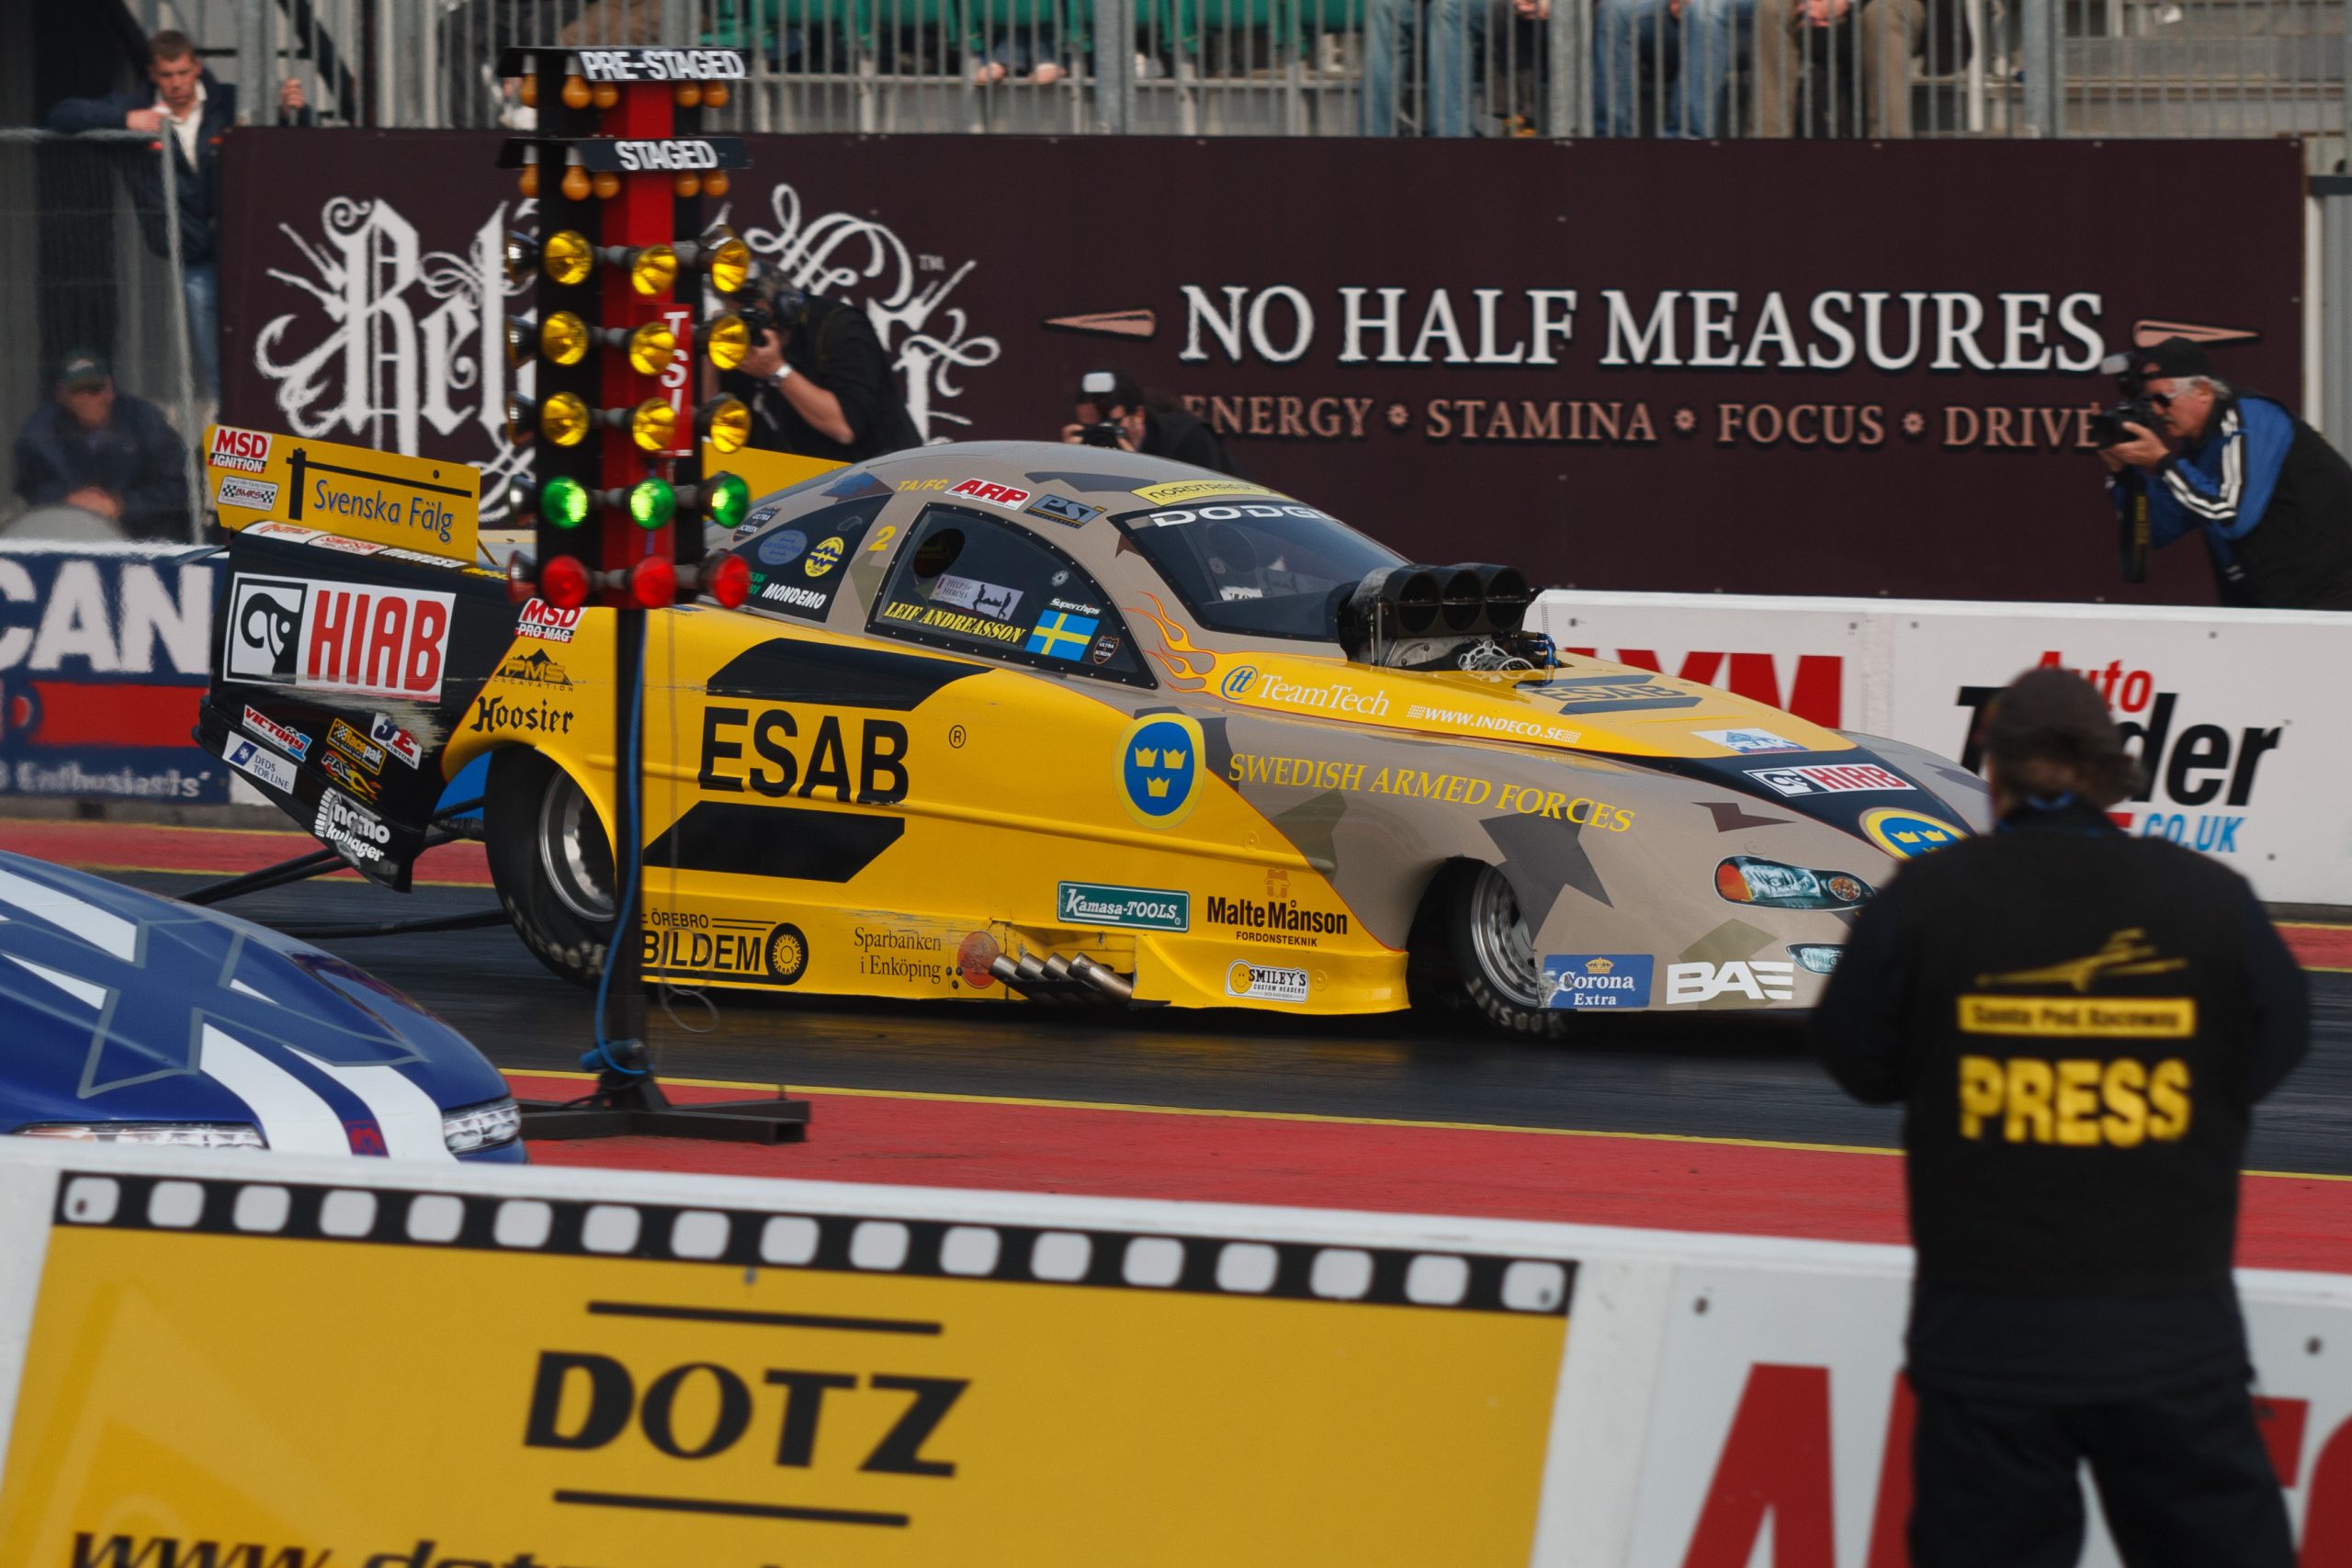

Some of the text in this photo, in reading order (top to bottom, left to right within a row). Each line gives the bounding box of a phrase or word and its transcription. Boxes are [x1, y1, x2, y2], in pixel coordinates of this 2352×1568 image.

[580, 50, 746, 80] PRE-STAGED
[615, 140, 718, 170] STAGED
[1180, 285, 2105, 371] NO HALF MEASURES
[1427, 398, 1656, 441] STAMINA
[1718, 403, 1885, 445] FOCUS
[1944, 405, 2099, 447] DRIVE
[215, 429, 267, 458] MSD
[213, 454, 264, 473] IGNITION
[897, 478, 949, 492] TA/FC
[951, 479, 1028, 503] ARP
[313, 479, 454, 544] Svenska Fälg
[867, 525, 897, 551] 2
[762, 582, 827, 609] MONDEMO
[1049, 598, 1101, 615] Superchips
[521, 600, 581, 628] MSD
[883, 602, 1027, 643] LEIF ANDREASSON
[307, 590, 447, 692] HIAB
[504, 658, 566, 682] PMS
[1259, 673, 1389, 716] TeamTech
[1532, 684, 1687, 702] ESAB
[245, 706, 304, 750] VICTORY
[469, 695, 574, 735] Hoosier
[1424, 706, 1565, 741] WWW.INDECO.SE
[254, 754, 277, 772] DFDS
[385, 742, 415, 766] PISTONS
[698, 705, 910, 806] ESAB
[254, 763, 289, 791] TOR LINE
[1798, 765, 1907, 790] HIAB
[1228, 753, 1636, 832] SWEDISH ARMED FORCES
[1066, 888, 1177, 919] Kamasa-TOOLS
[1206, 896, 1348, 934] Malte Månson
[651, 908, 709, 929] ÖREBRO
[854, 926, 942, 953] Sparbanken
[1236, 931, 1317, 947] FORDONSTEKNIK
[860, 956, 942, 985] i Enköping
[1249, 969, 1306, 986] SMILEY'S
[1559, 971, 1634, 992] Corona
[1666, 960, 1794, 1005] BAE
[1280, 986, 1305, 994] HEADERS
[1573, 992, 1617, 1006] Extra
[1959, 1055, 2192, 1146] PRESS
[523, 1349, 972, 1478] DOTZ
